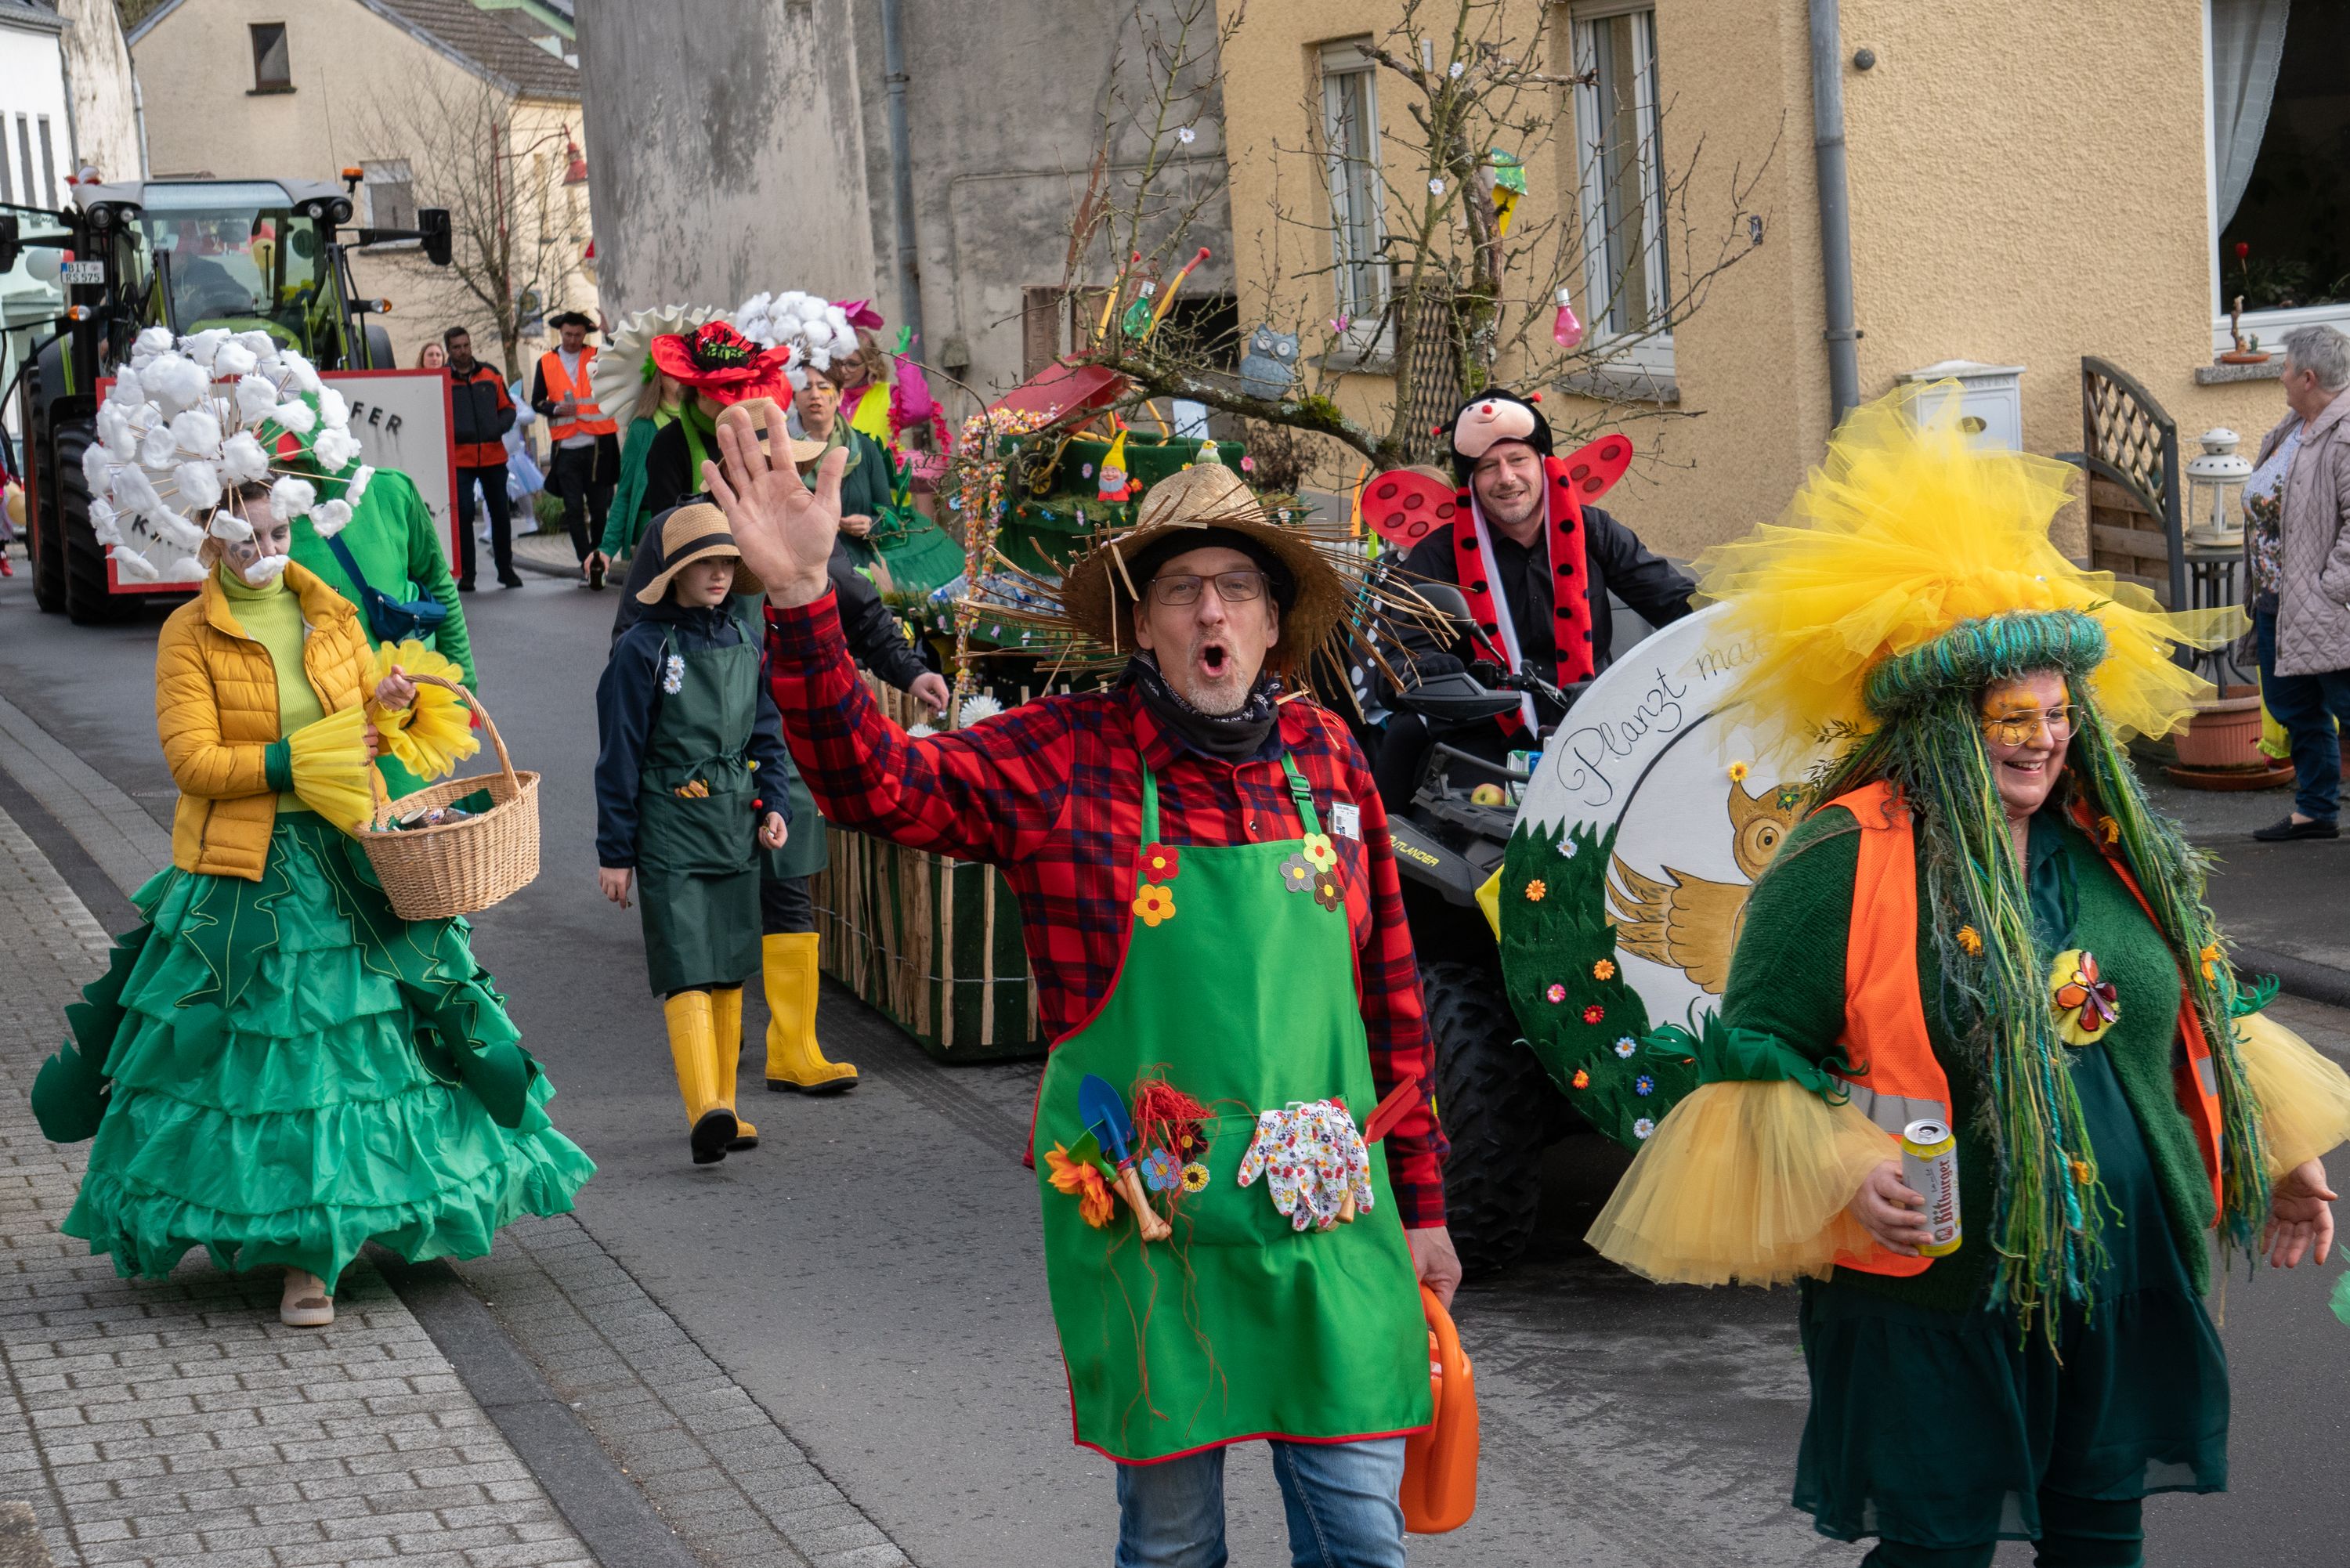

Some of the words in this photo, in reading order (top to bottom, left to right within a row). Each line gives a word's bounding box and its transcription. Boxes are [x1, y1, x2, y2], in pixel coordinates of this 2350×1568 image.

[68, 263, 88, 273] BIT
[66, 273, 79, 282] RS
[81, 273, 99, 282] 575
[1932, 1159, 1953, 1226] Bitburger
